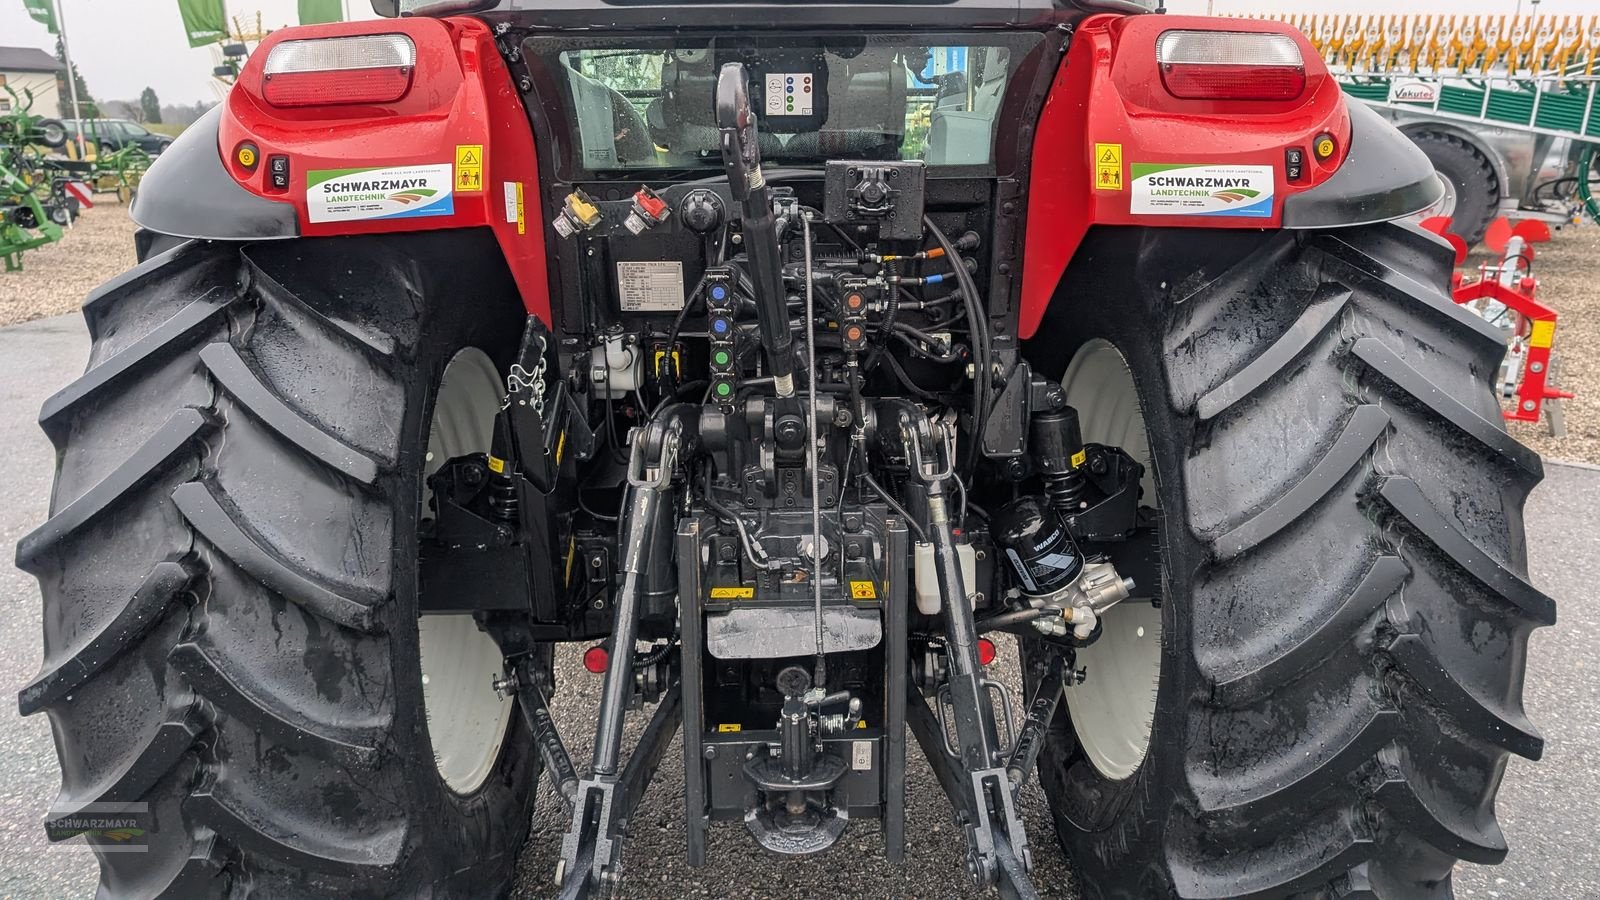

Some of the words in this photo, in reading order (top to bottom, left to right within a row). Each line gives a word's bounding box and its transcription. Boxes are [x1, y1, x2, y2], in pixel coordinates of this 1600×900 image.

[323, 179, 427, 193] SCHWARZMAYR
[1148, 176, 1250, 188] SCHWARZMAYR
[326, 193, 386, 203] LANDTECHNIK
[1150, 189, 1210, 197] LANDTECHNIK
[1033, 529, 1060, 552] WABCO
